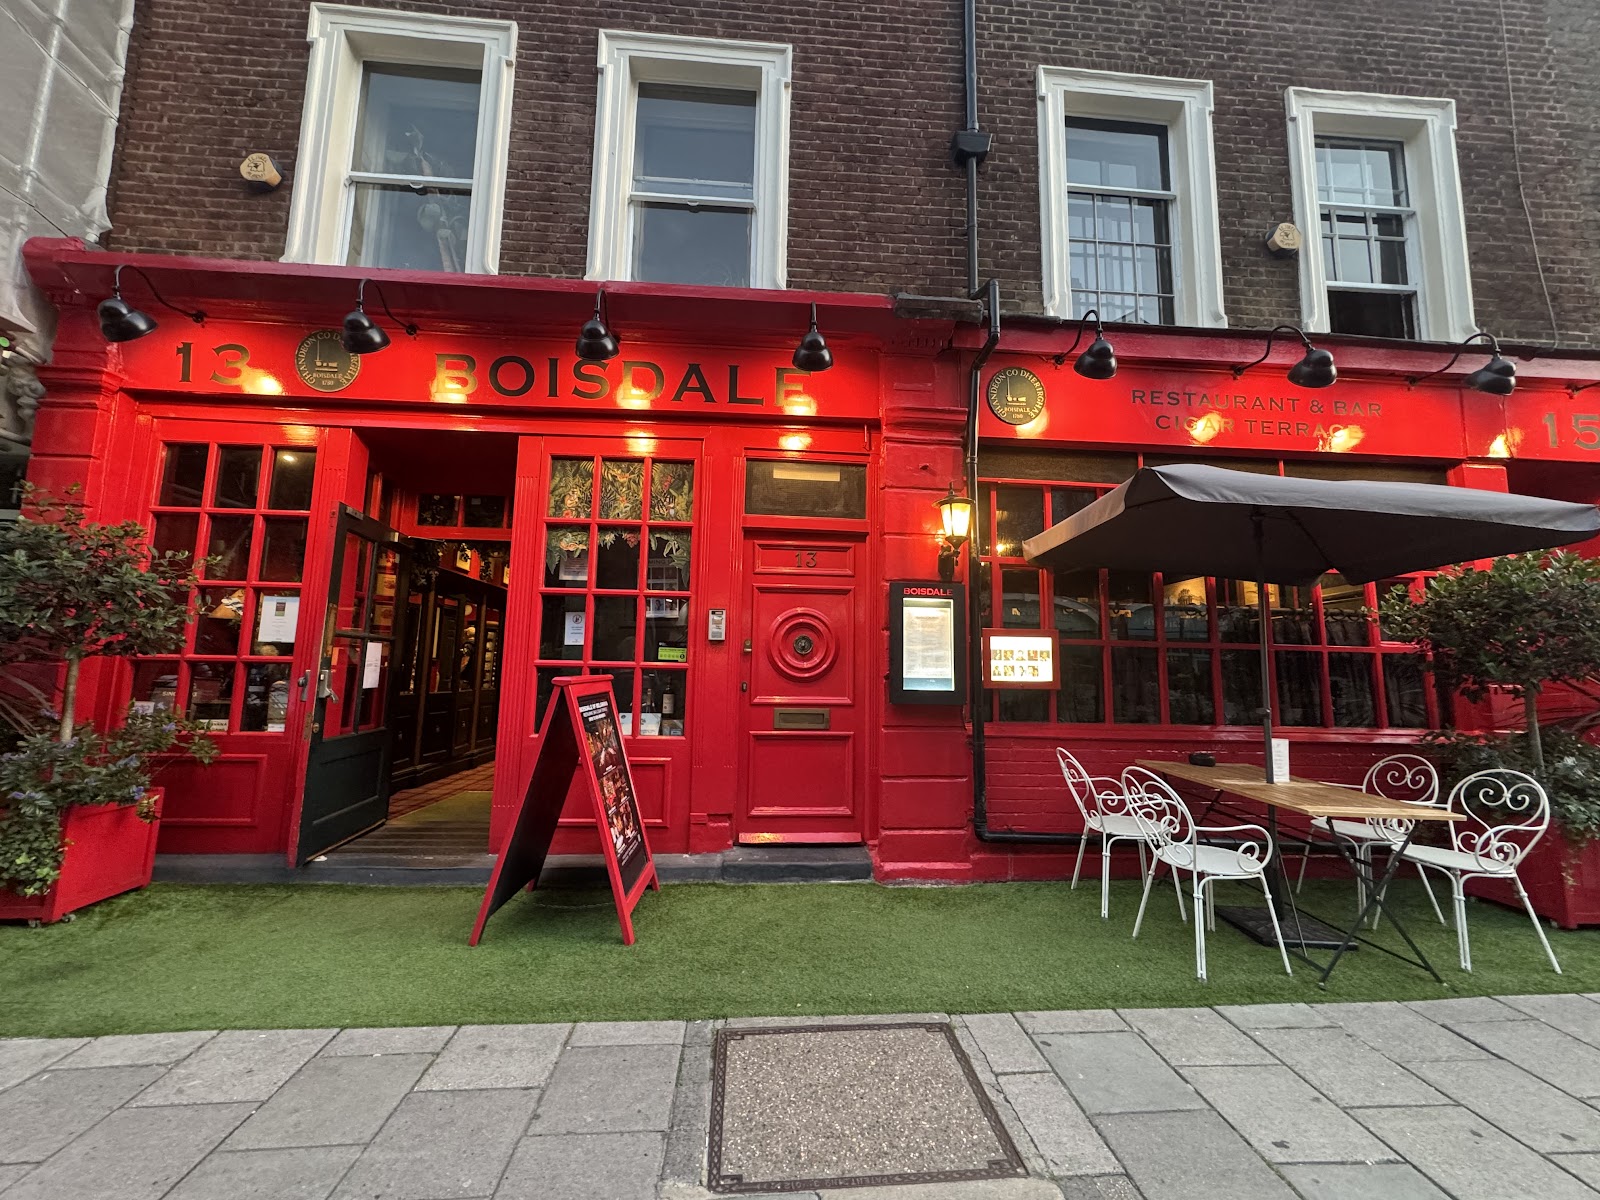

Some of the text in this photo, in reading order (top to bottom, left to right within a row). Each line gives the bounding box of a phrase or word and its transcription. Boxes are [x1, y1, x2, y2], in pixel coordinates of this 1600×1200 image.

[317, 332, 331, 340] CO
[176, 341, 250, 385] 13
[1006, 369, 1018, 377] CO
[434, 352, 813, 407] BOISDALE
[1131, 389, 1382, 417] RESTAURANT & BAR
[1155, 415, 1363, 438] CIGAR TERRACE
[1542, 411, 1600, 450] 15
[795, 550, 817, 568] 13
[903, 587, 953, 596] BOISDALE
